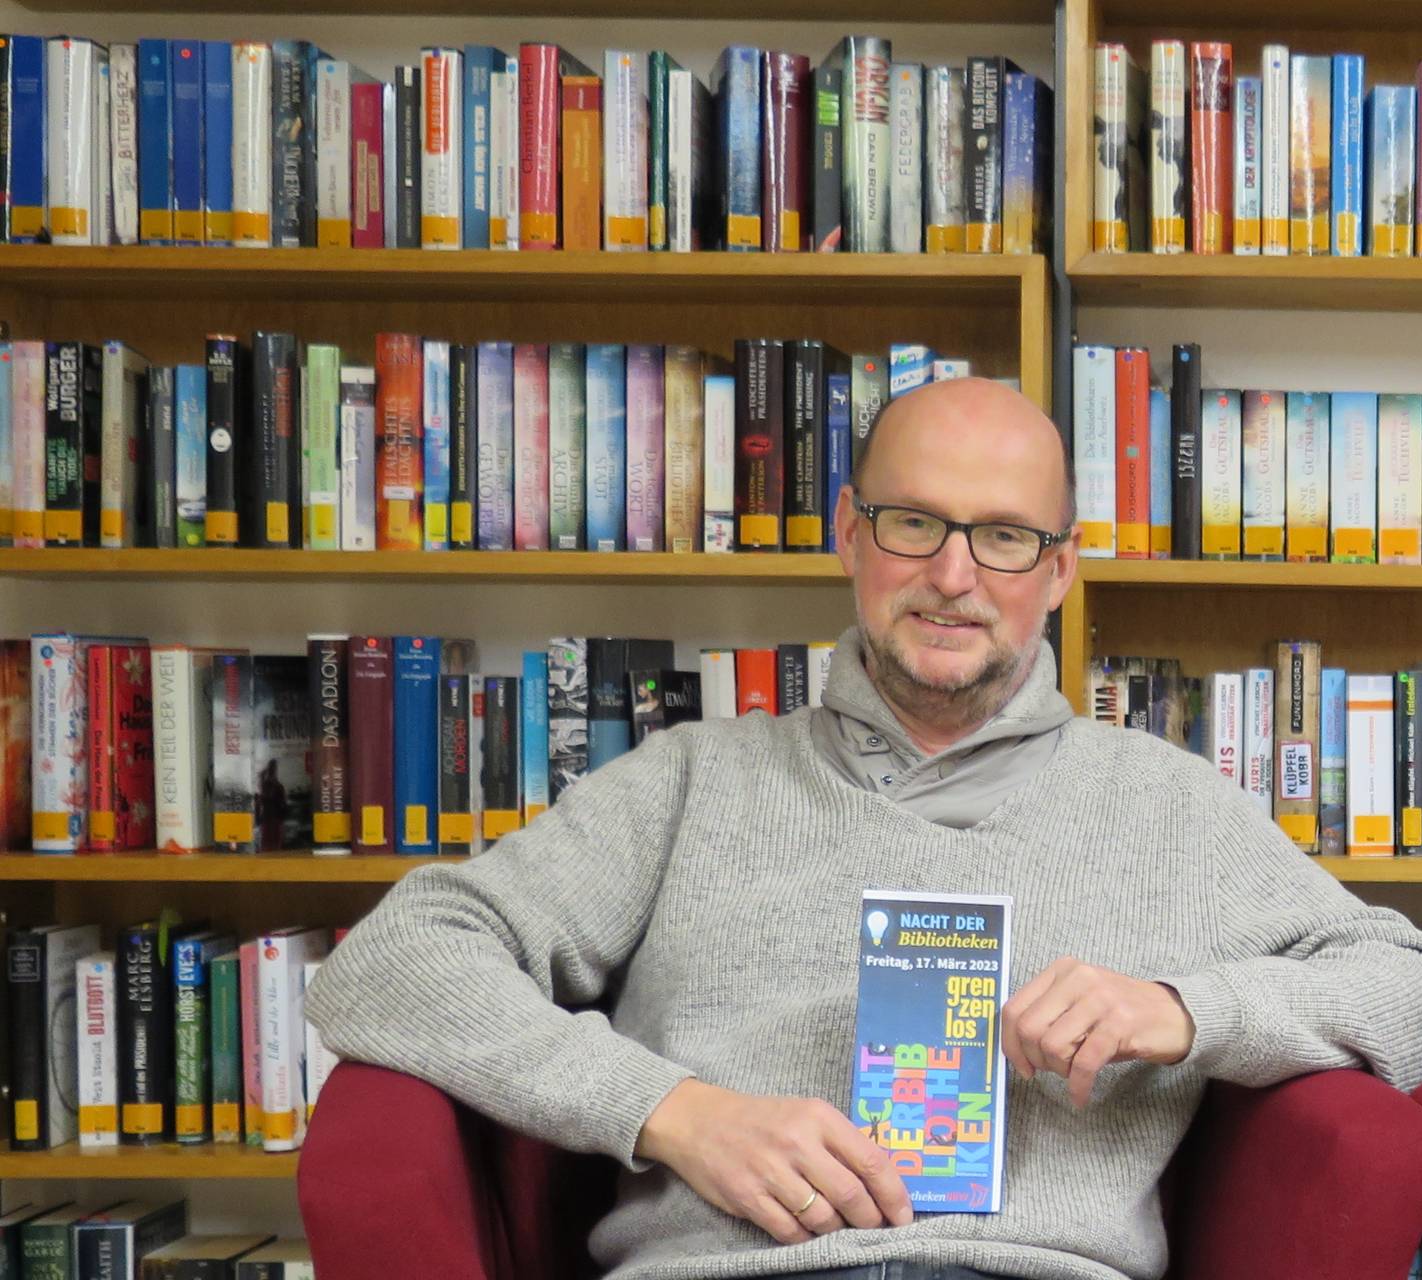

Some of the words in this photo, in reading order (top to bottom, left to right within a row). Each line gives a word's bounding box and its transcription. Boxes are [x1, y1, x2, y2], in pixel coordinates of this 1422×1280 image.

[521, 62, 534, 106] Berkel
[972, 61, 985, 105] BITCOIN
[985, 66, 998, 124] KOMPLOTT
[117, 69, 134, 161] BITTERHERZ
[972, 108, 985, 130] DAS
[521, 109, 535, 174] Christian
[867, 132, 877, 162] DAN
[867, 168, 878, 222] BROWN
[48, 358, 60, 411] Wolfgang
[60, 345, 77, 421] BURGER
[757, 350, 767, 419] PRÄSIDENTEN
[857, 397, 871, 439] SUCHE
[804, 433, 814, 482] PATTERSON
[158, 654, 176, 698] WELT
[319, 649, 339, 711] ADLON
[794, 663, 804, 706] AKRAM
[1292, 659, 1303, 728] FUNKENMORD
[49, 701, 57, 717] DER
[160, 702, 176, 731] DER
[49, 719, 57, 757] STIMMEN
[161, 735, 177, 762] TEIL
[225, 729, 238, 756] BESTE
[319, 715, 339, 748] DAS
[454, 719, 467, 774] MORDEN
[1407, 738, 1416, 763] Michael
[163, 766, 178, 805] KEIN
[1250, 756, 1260, 793] AURIS
[1284, 747, 1298, 795] KLÜPFEL
[1297, 755, 1309, 786] KOBR
[897, 931, 999, 951] Bibliotheken
[899, 913, 950, 931] NACHT
[955, 914, 985, 931] DER
[127, 951, 140, 1001] MARC
[139, 941, 153, 1012] ELSBERG
[866, 954, 914, 971] Freitag,
[916, 956, 935, 970] 17.
[937, 955, 967, 971] März
[968, 958, 999, 972] 2023
[85, 975, 105, 1036] BLUTGOTT
[178, 985, 196, 1022] HORST
[946, 974, 996, 1008] gren
[958, 998, 996, 1020] zen
[945, 1007, 978, 1039] los
[956, 1091, 993, 1174] KEN
